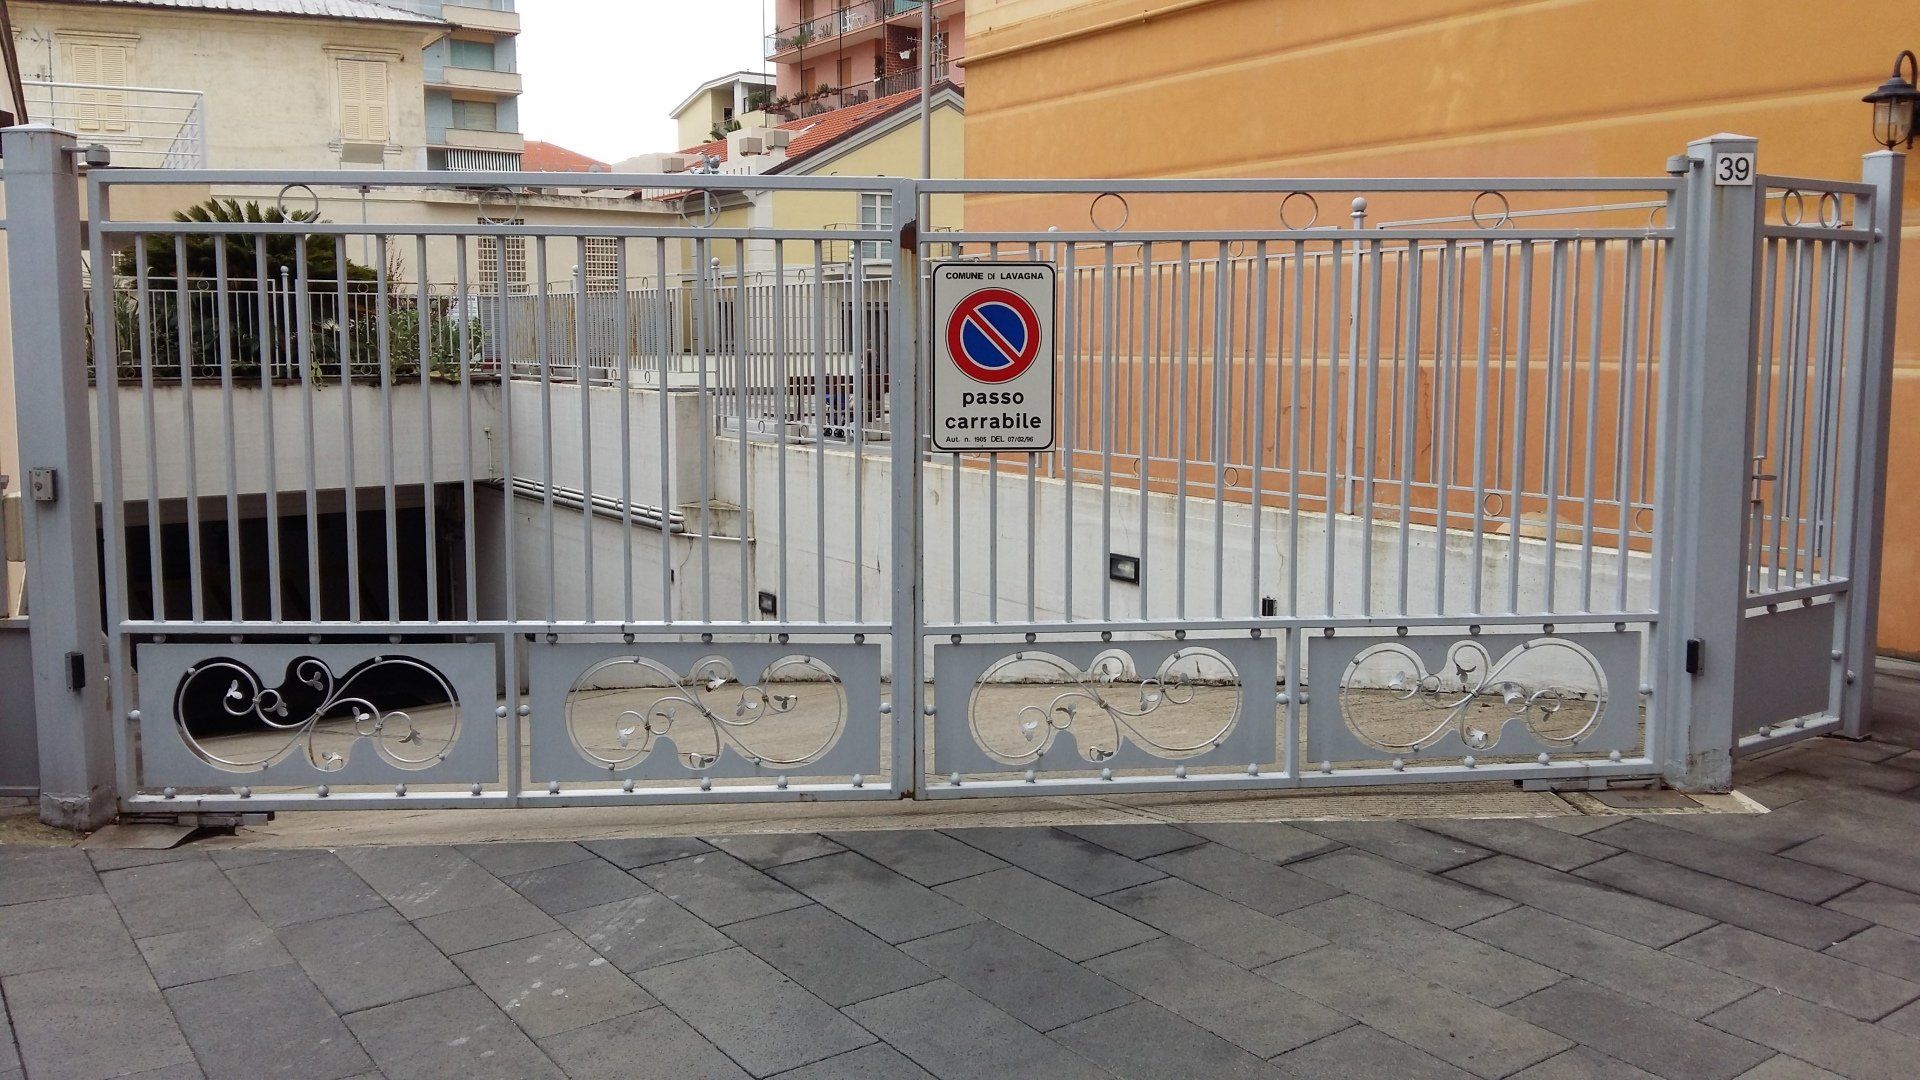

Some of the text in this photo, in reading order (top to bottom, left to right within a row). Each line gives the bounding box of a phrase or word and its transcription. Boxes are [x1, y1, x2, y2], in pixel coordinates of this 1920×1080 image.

[1719, 157, 1750, 181] 39
[945, 272, 1044, 280] COMUNE DI LAVAGNA
[962, 391, 1024, 407] passo
[945, 413, 1042, 429] carrabile
